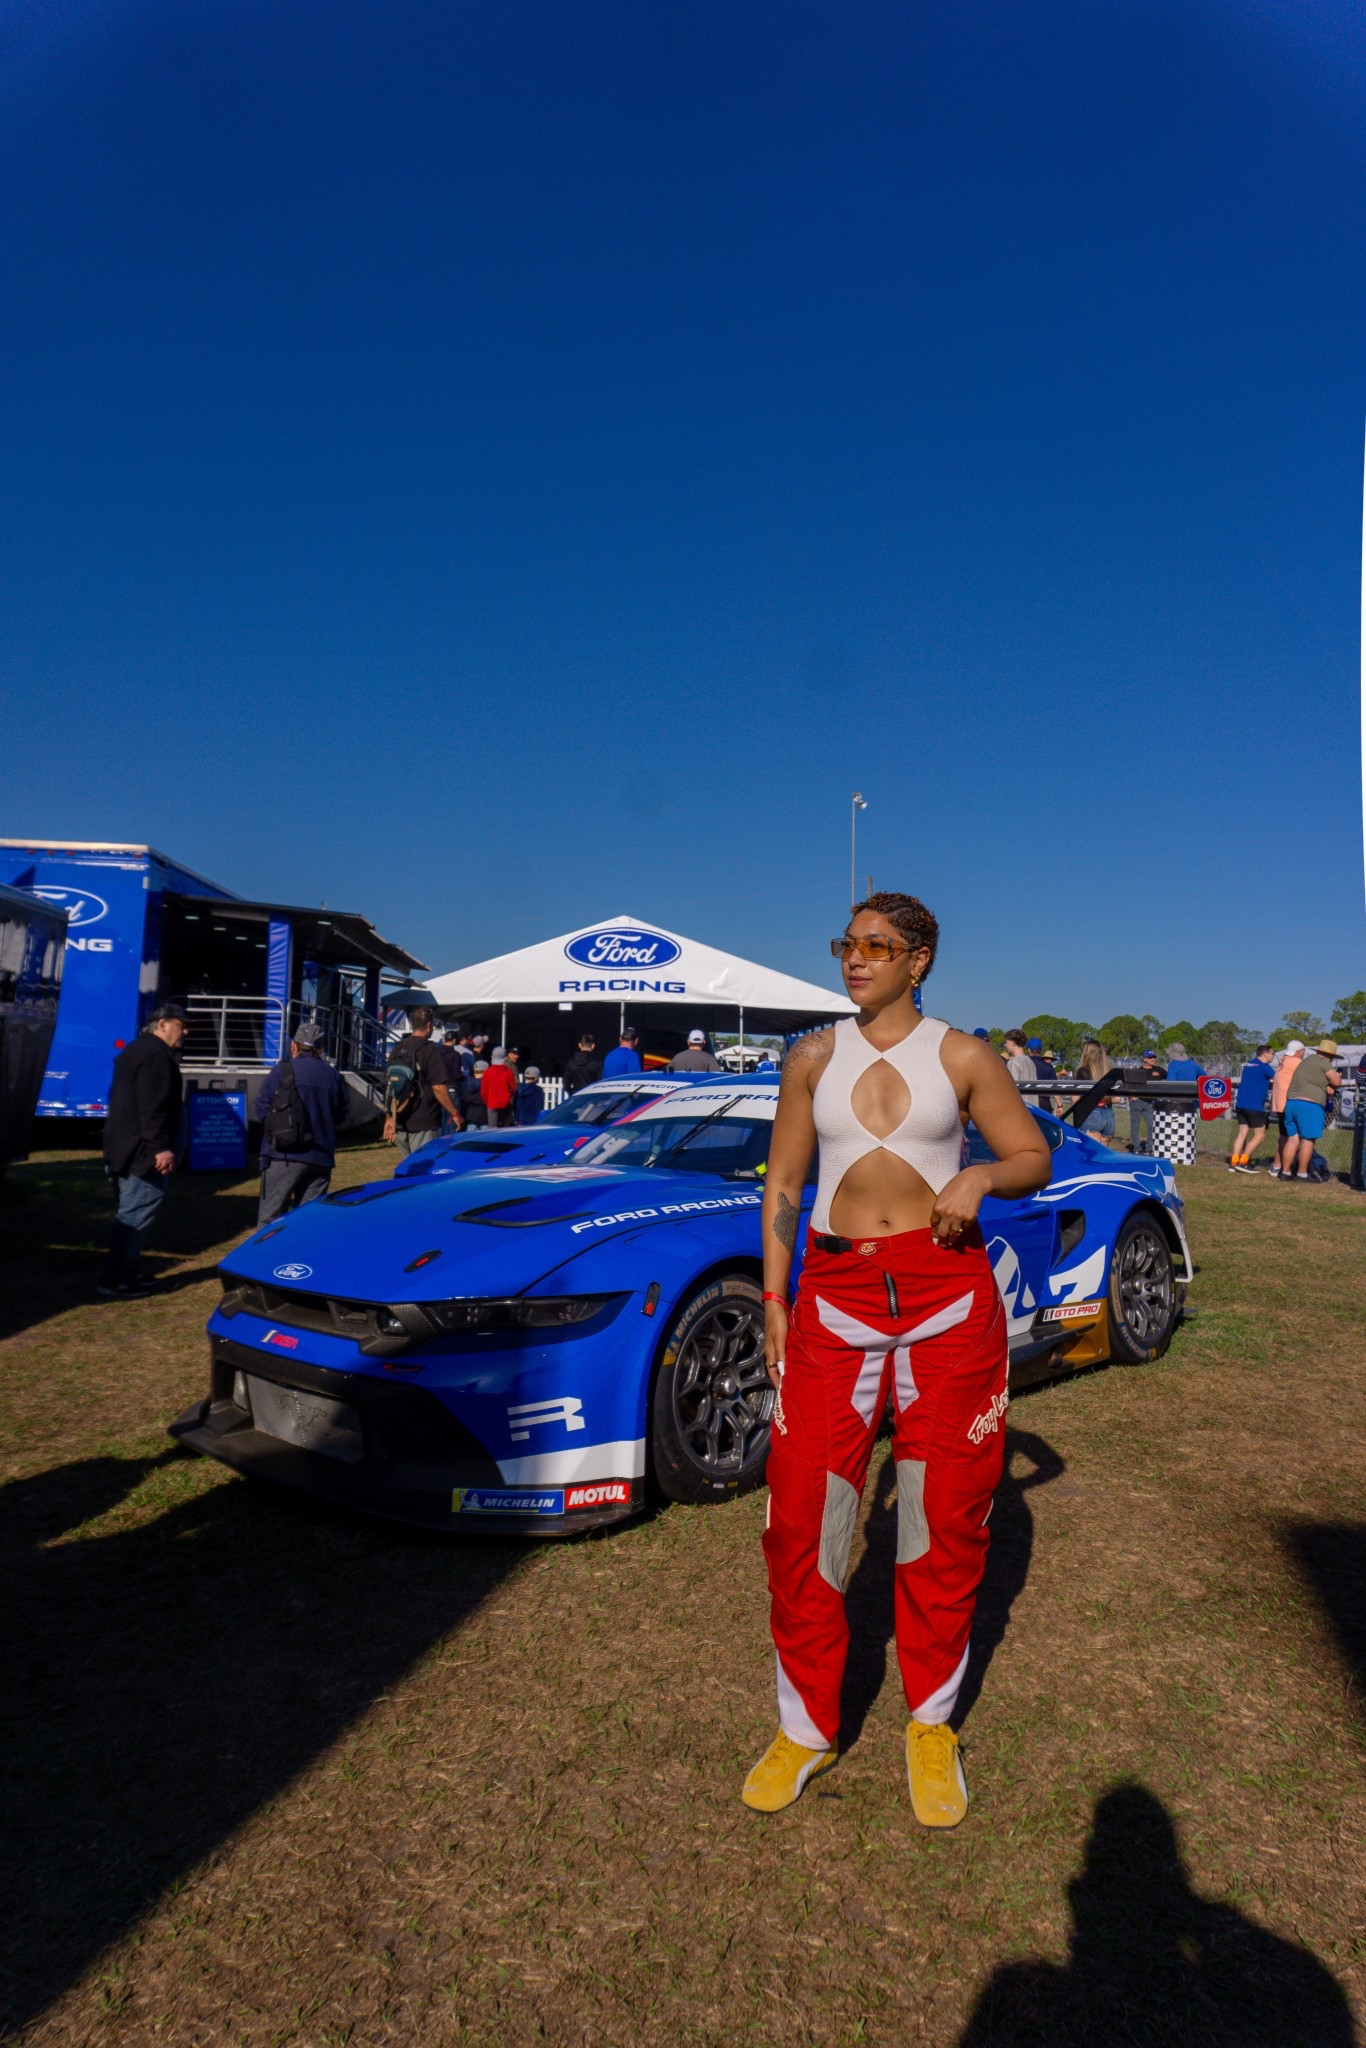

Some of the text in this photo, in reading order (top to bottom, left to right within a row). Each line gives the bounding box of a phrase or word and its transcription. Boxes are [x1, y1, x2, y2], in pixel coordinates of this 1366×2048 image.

[588, 934, 658, 964] Ford
[559, 979, 686, 993] RACING
[664, 1094, 732, 1104] FORD
[570, 1195, 762, 1234] FORD RACING
[674, 1287, 719, 1339] MICHELIN
[1054, 1304, 1099, 1318] GTD PRO
[483, 1497, 555, 1508] MICHELIN
[568, 1485, 626, 1506] MOTUL
